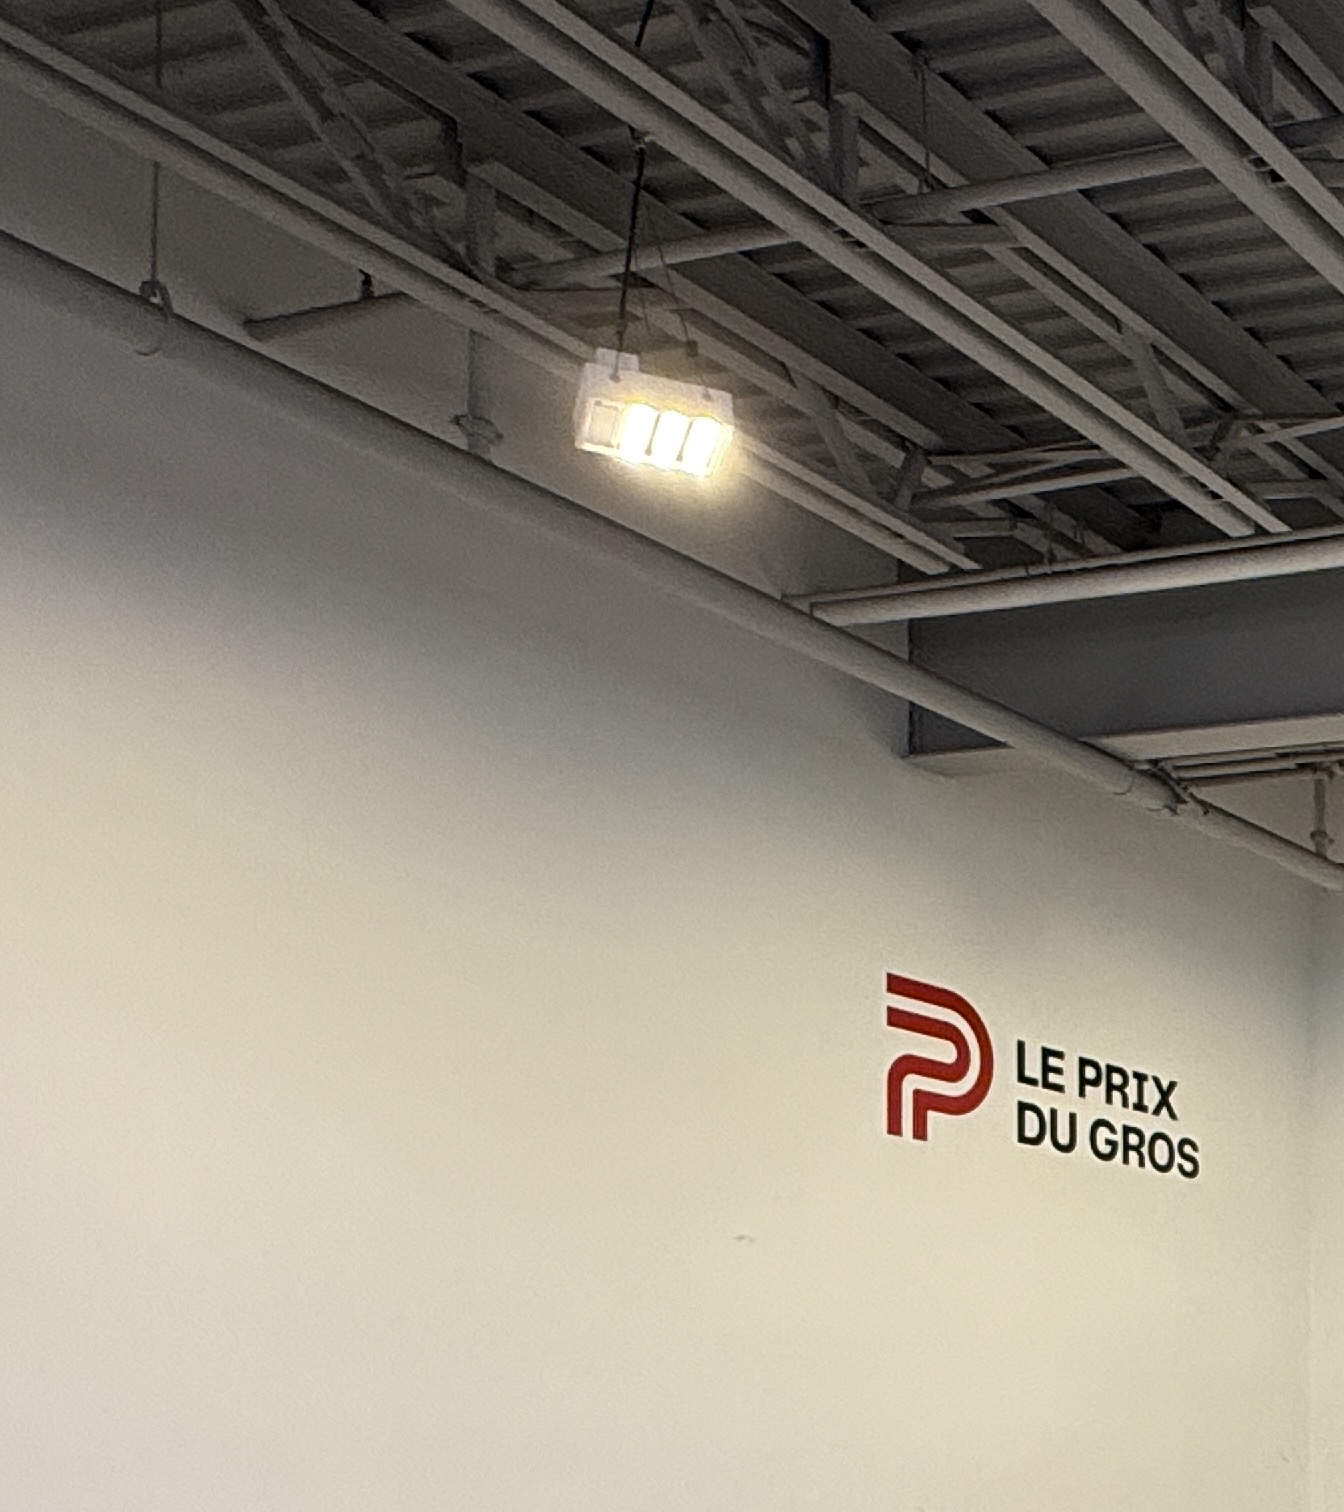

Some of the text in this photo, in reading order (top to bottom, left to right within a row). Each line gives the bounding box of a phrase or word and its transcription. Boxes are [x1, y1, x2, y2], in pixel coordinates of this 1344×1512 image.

[1016, 1039, 1179, 1121] LE PRIX
[1016, 1099, 1200, 1179] DU GROS
